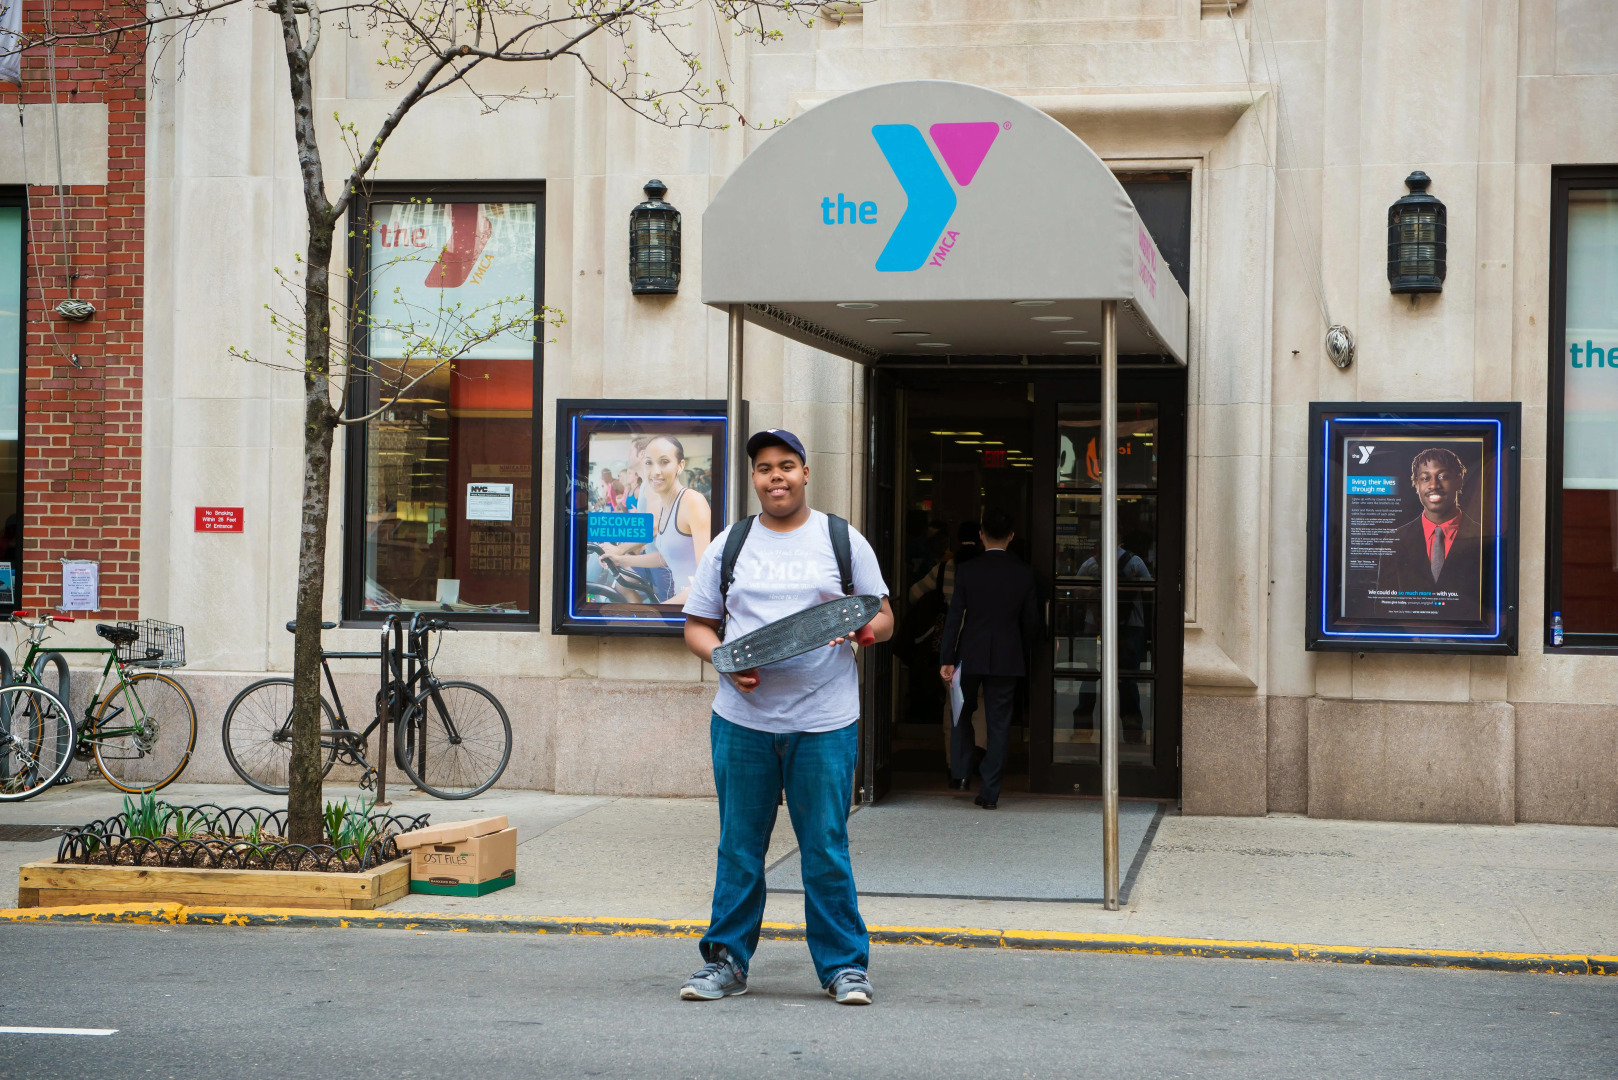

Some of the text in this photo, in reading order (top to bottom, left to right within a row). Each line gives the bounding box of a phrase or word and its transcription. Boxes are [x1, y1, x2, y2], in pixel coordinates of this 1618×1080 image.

[820, 192, 878, 225] the
[379, 221, 427, 248] the
[929, 230, 961, 267] YMCA
[469, 253, 495, 285] YMCA
[1569, 339, 1618, 369] the
[984, 450, 1006, 468] EXIT
[1351, 478, 1396, 487] living their lives
[1351, 486, 1375, 494] through
[589, 516, 645, 527] DISCOVER
[589, 527, 646, 538] WELLNESS
[750, 560, 821, 581] YMCA
[444, 854, 468, 865] FILES
